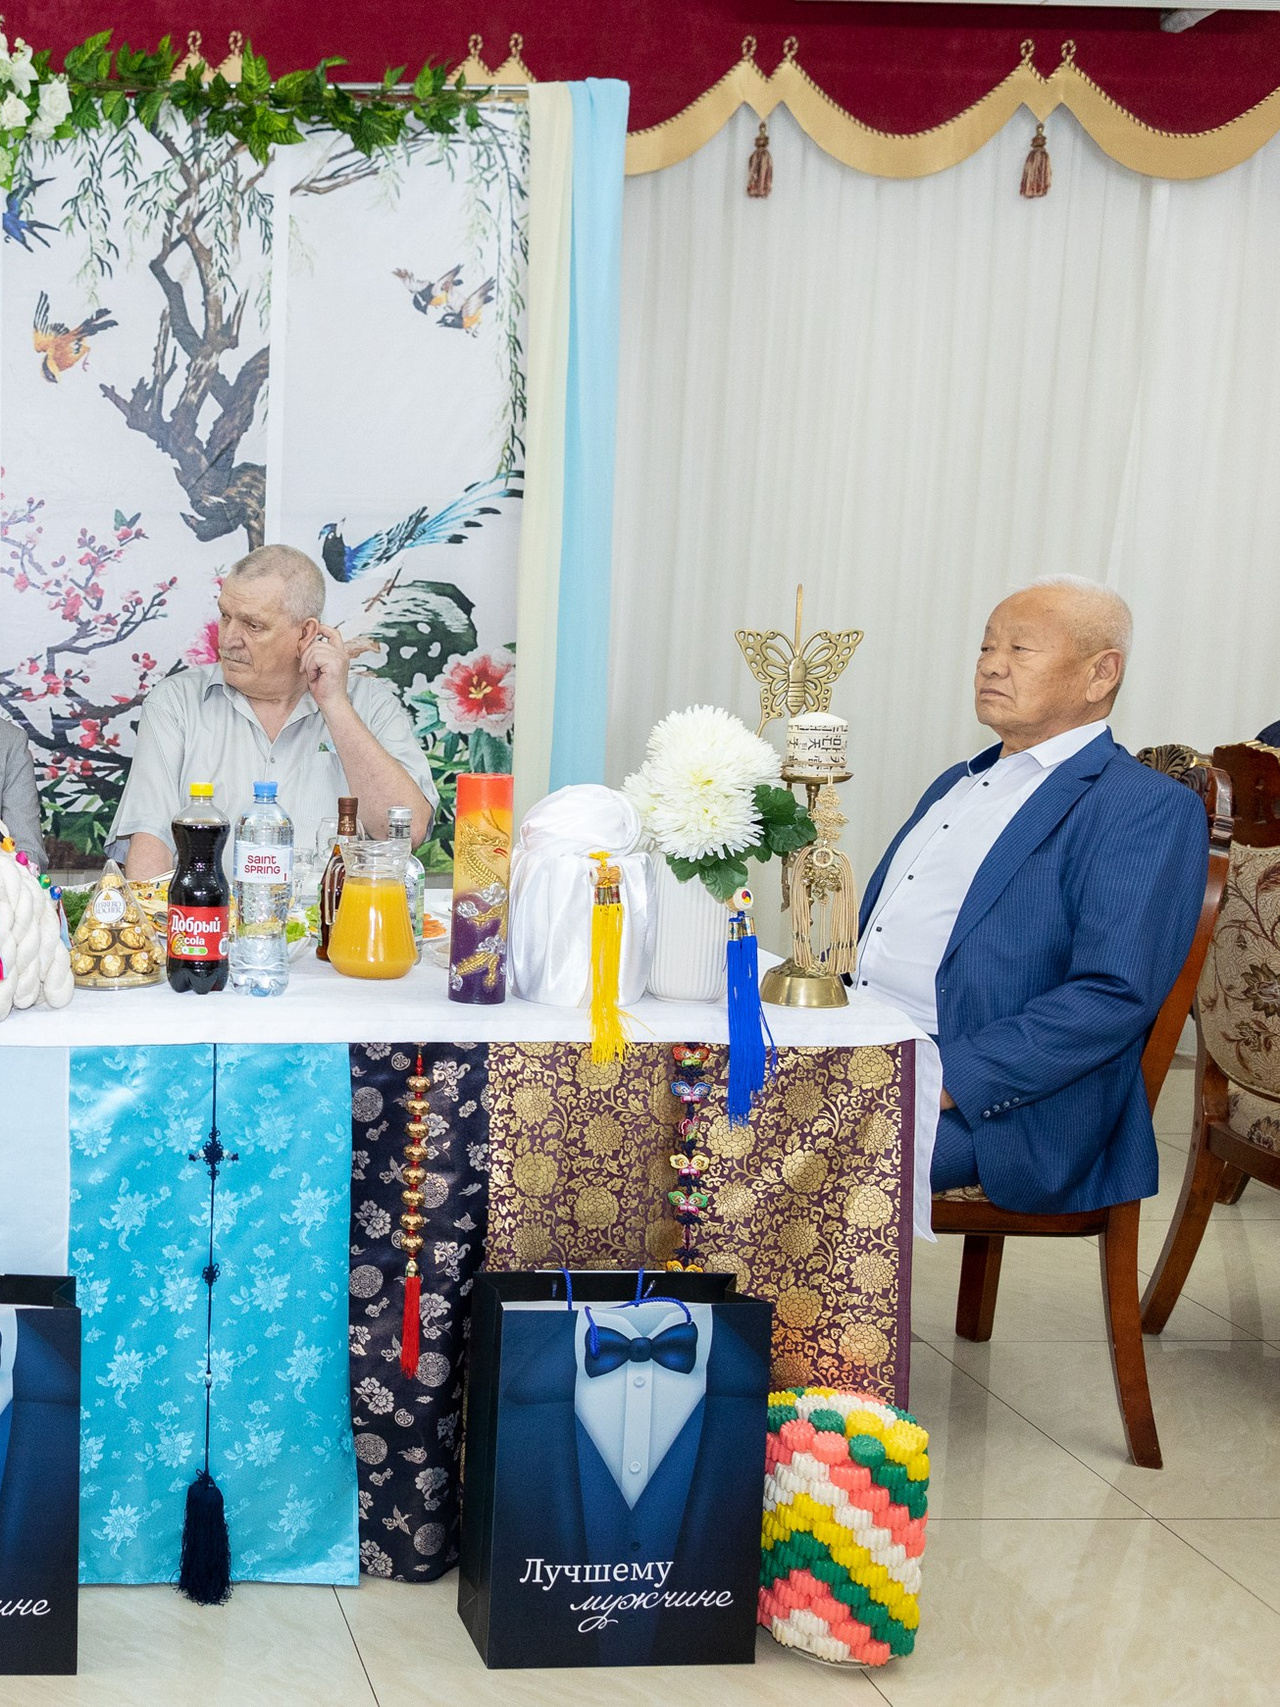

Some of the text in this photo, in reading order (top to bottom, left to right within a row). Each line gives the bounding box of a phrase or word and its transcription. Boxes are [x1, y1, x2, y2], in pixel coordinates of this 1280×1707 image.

[171, 914, 221, 936] Добрый
[183, 935, 206, 946] cola
[519, 1558, 674, 1591] Лучшему
[569, 1590, 734, 1633] мужчине
